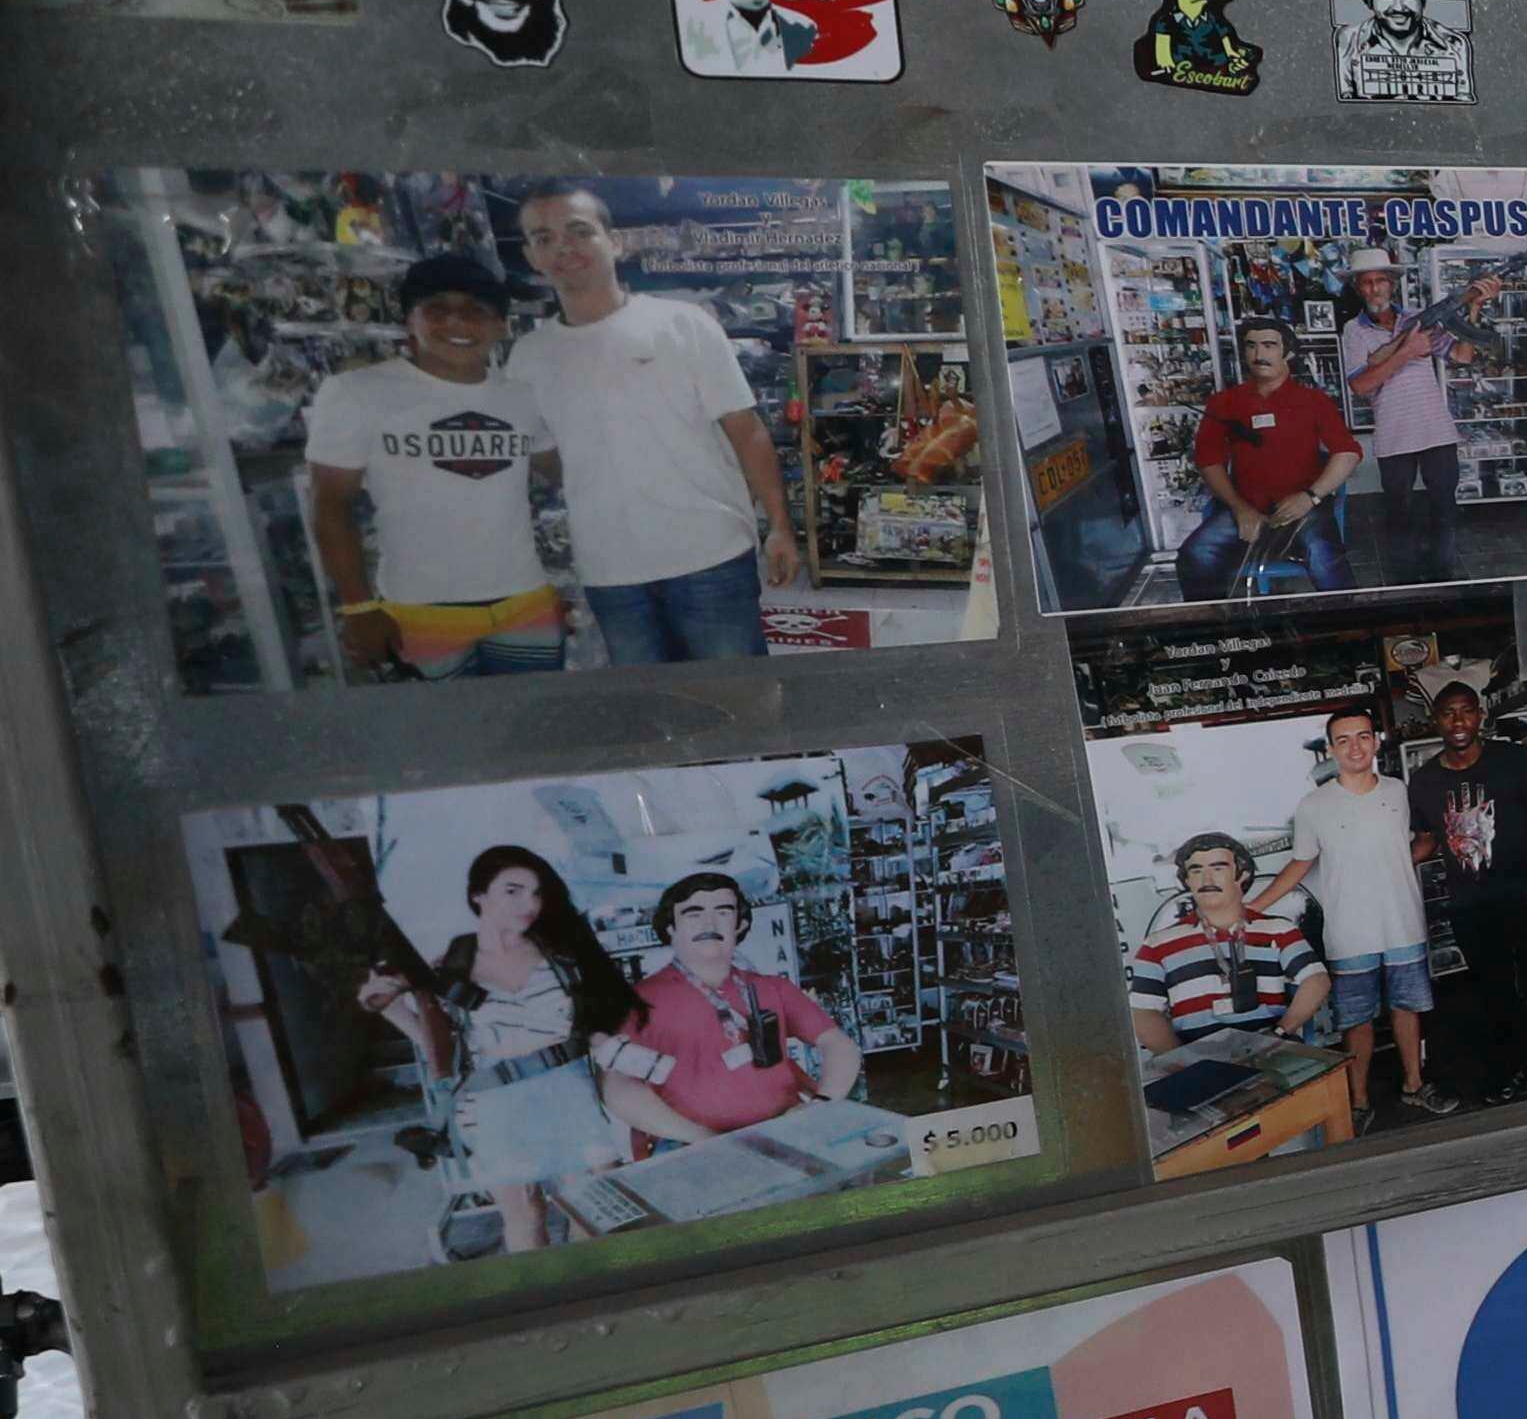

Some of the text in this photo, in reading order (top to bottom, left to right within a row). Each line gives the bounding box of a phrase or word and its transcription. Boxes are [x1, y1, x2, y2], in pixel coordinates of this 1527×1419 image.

[1172, 63, 1250, 92] Escobart
[1095, 198, 1374, 241] COMANDANTE
[922, 1118, 1020, 1153] $ 5.000
